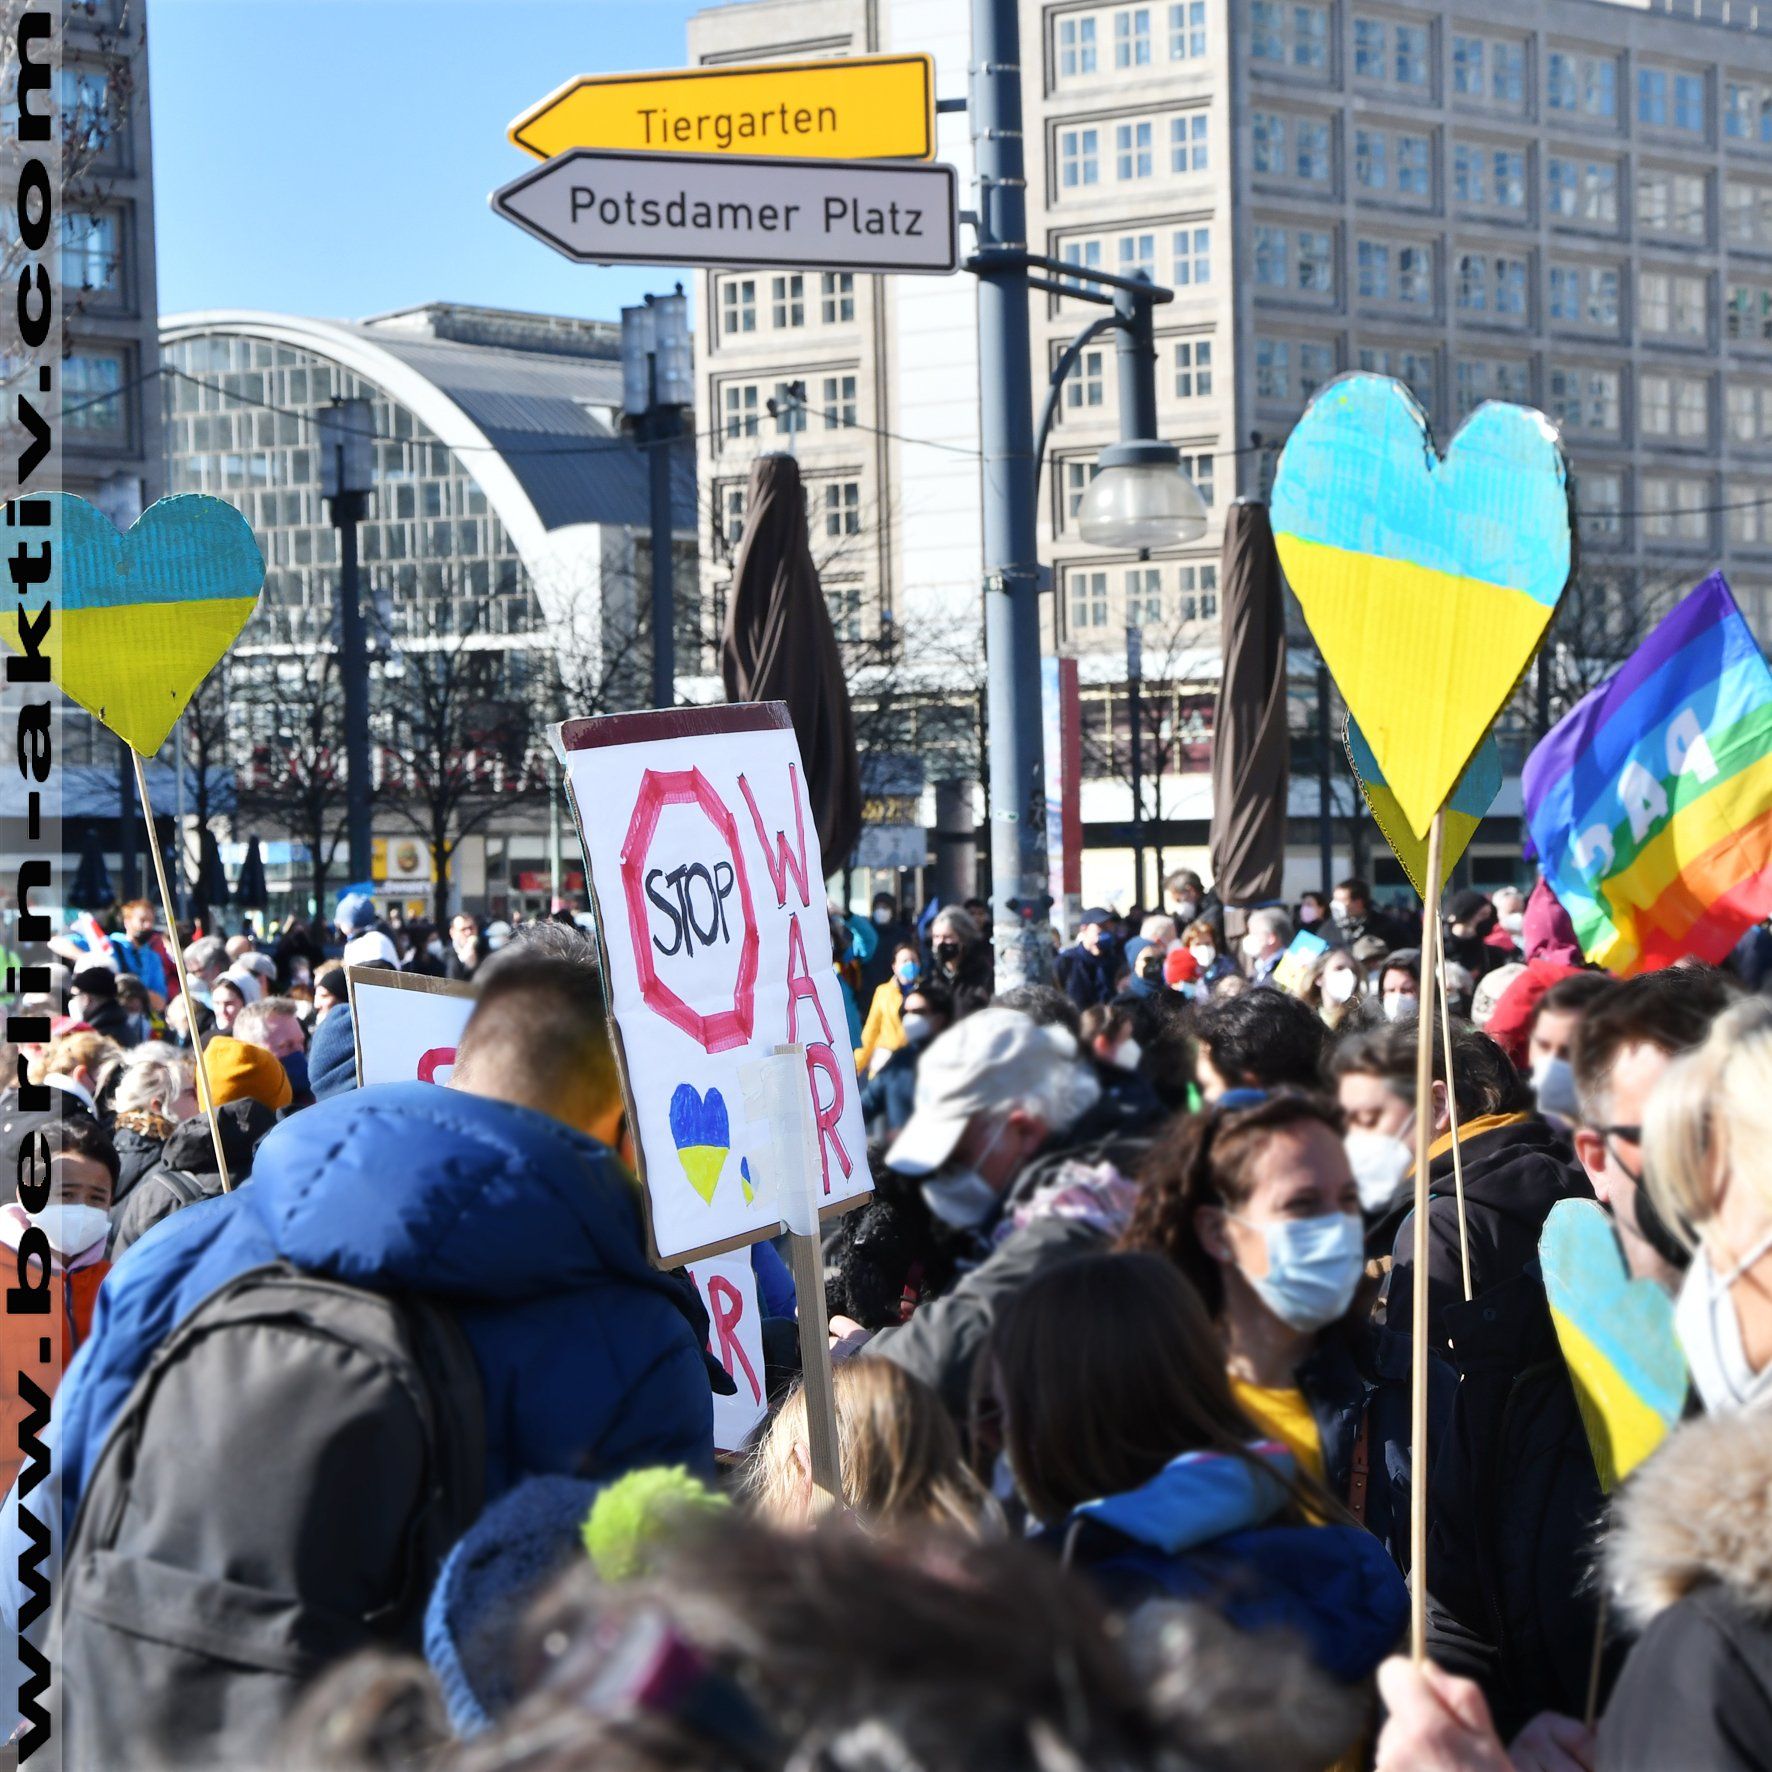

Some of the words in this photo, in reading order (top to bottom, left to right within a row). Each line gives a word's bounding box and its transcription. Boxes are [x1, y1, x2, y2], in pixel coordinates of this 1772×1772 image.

[636, 102, 837, 149] Tiergarten
[569, 185, 800, 232] Potsdamer
[823, 197, 924, 237] Platz
[645, 861, 735, 958] STOP
